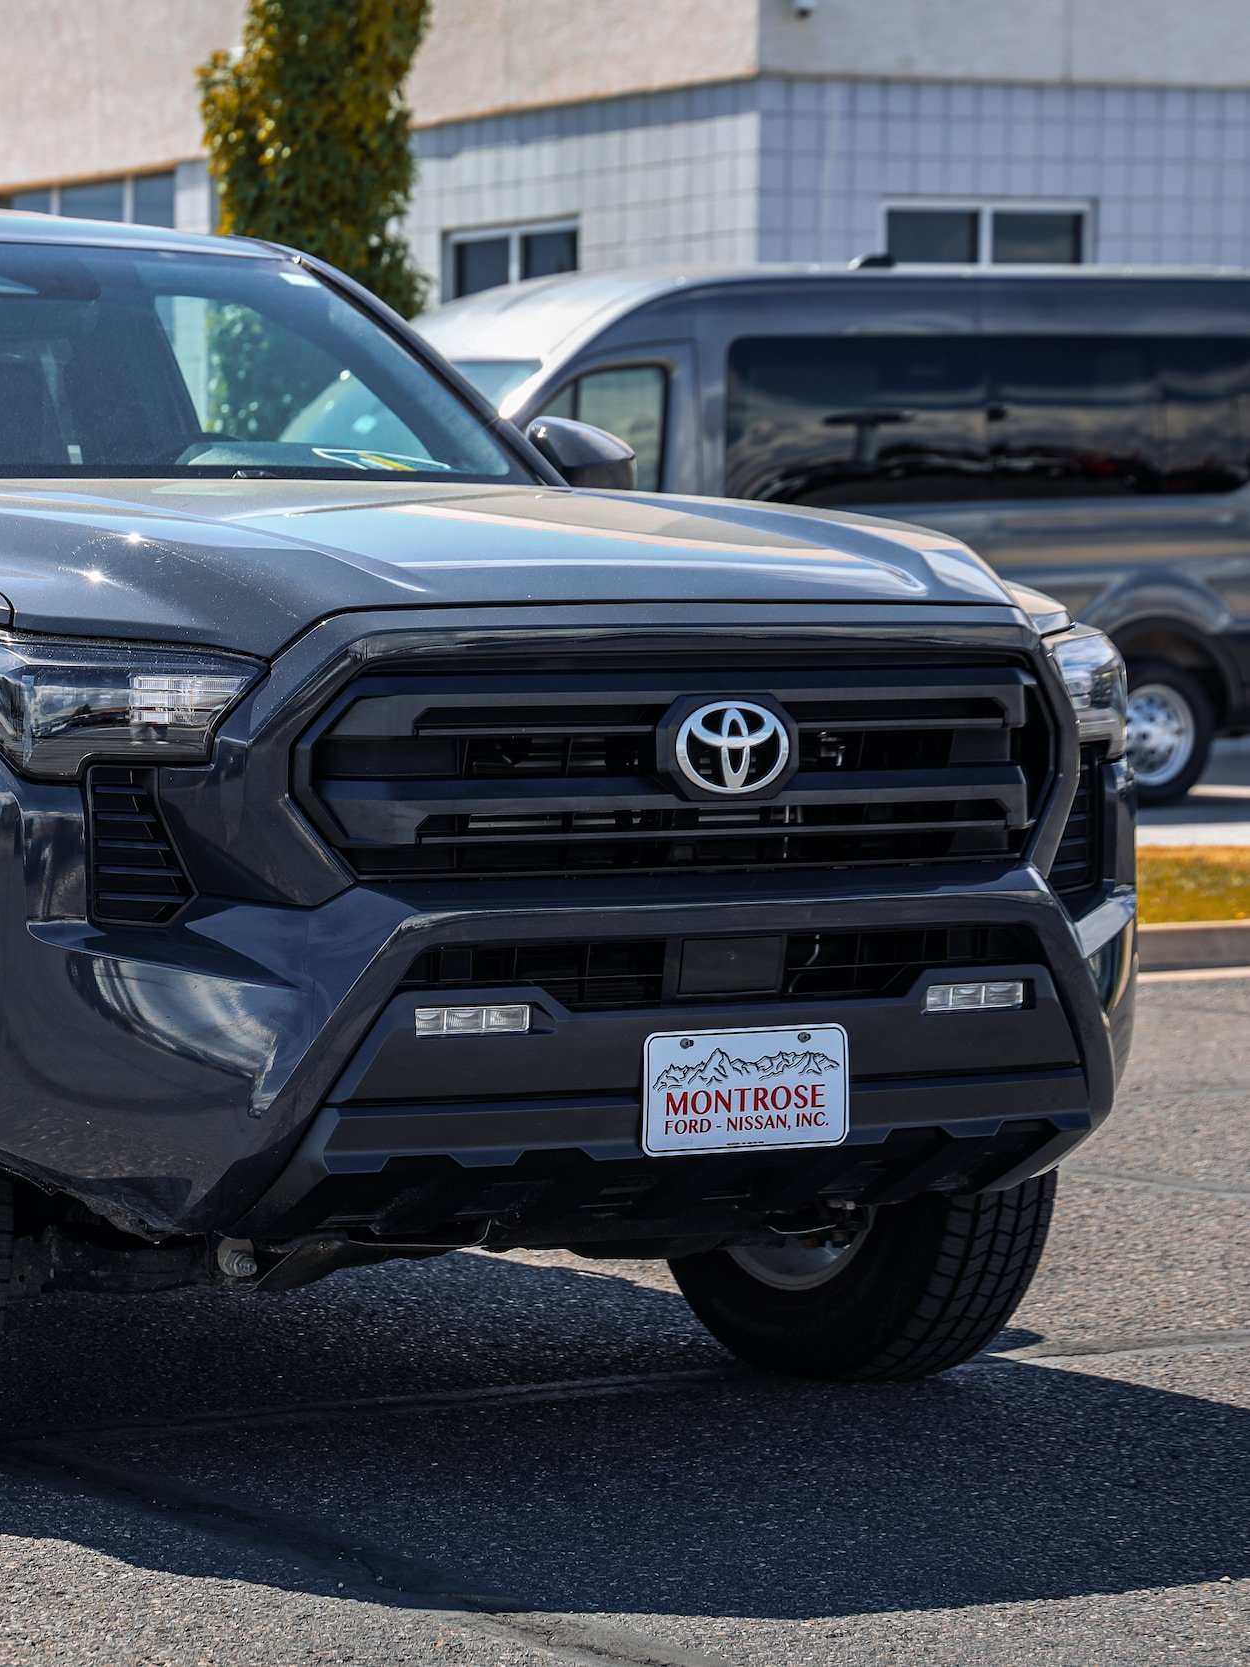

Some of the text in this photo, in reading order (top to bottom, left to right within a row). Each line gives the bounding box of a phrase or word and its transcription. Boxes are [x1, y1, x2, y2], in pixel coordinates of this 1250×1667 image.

[664, 1084, 826, 1117] MONTROSE
[664, 1118, 712, 1135] FORD
[726, 1114, 791, 1132] NISSAN,
[796, 1112, 829, 1129] INC.
